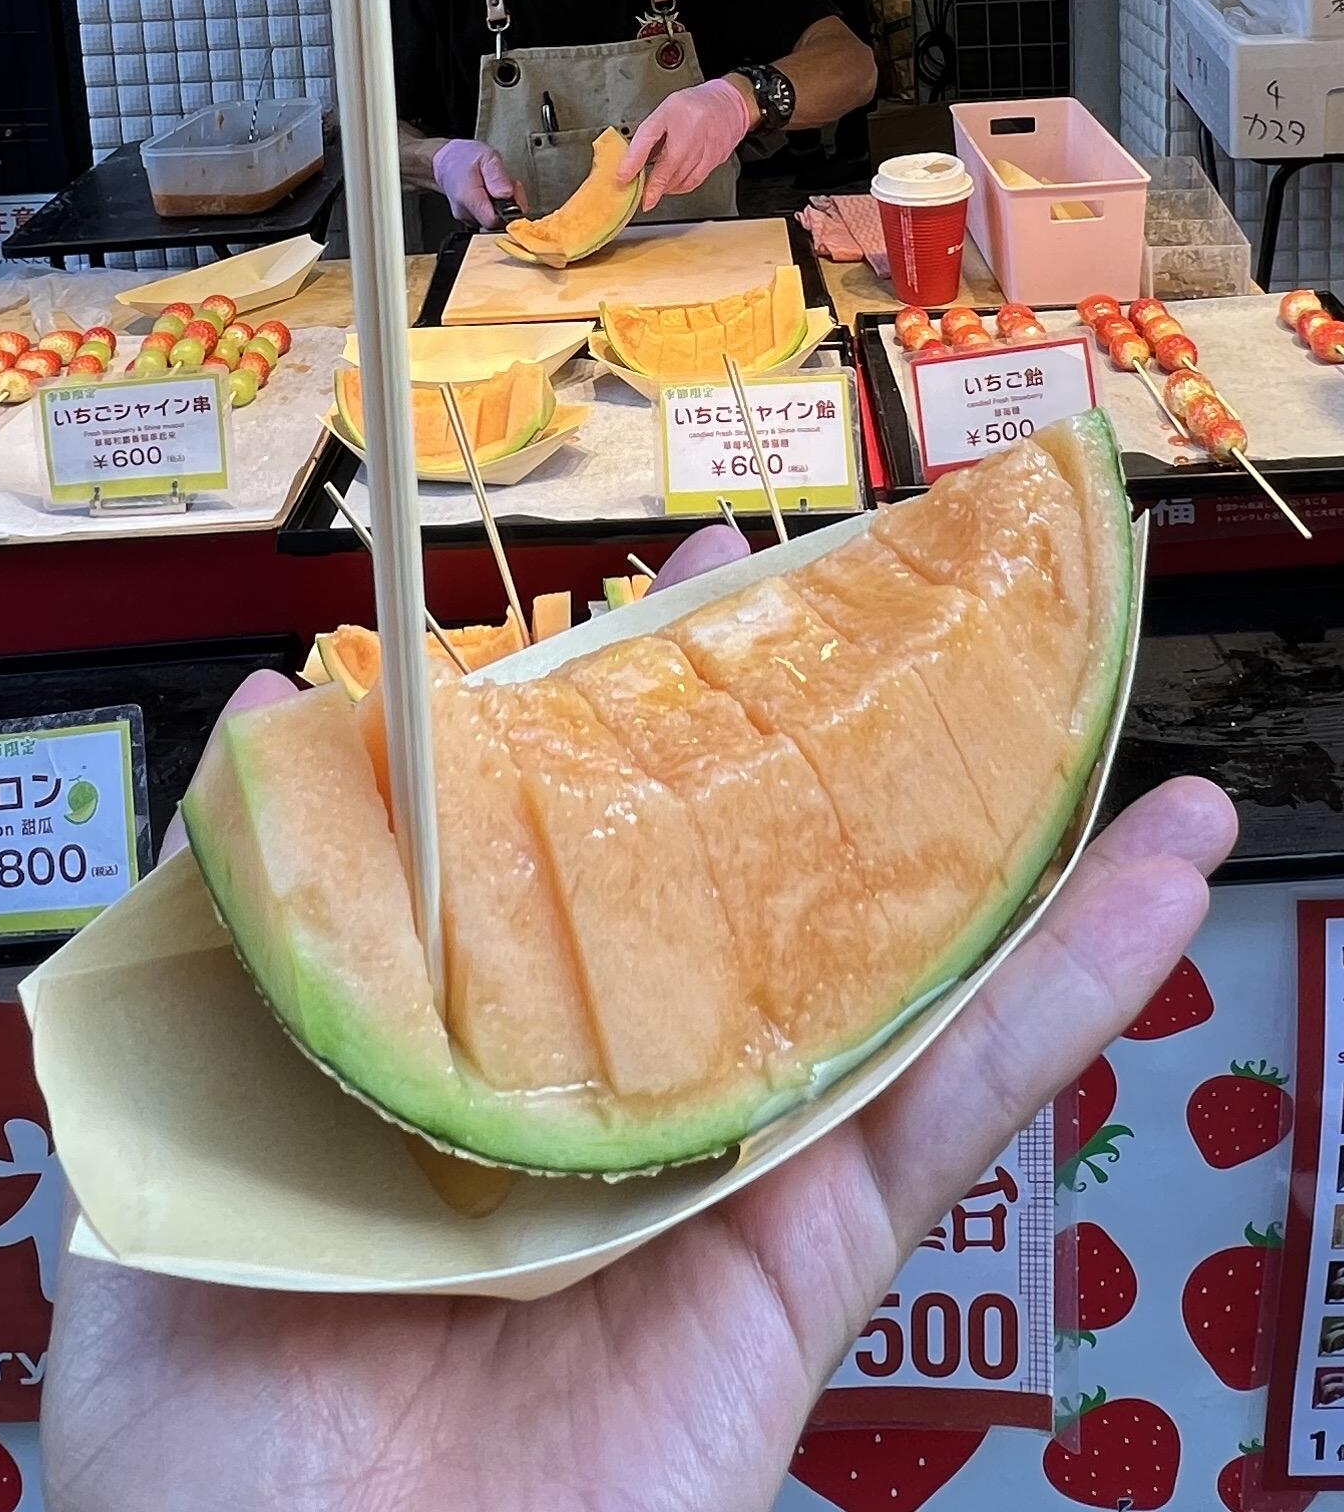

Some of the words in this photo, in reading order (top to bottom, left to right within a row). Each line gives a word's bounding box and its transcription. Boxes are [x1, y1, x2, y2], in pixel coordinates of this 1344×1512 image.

[964, 367, 1043, 394] いちご飴
[54, 395, 211, 426] いちごシャイン串
[966, 419, 1034, 446] ¥500
[92, 445, 162, 470] ¥600
